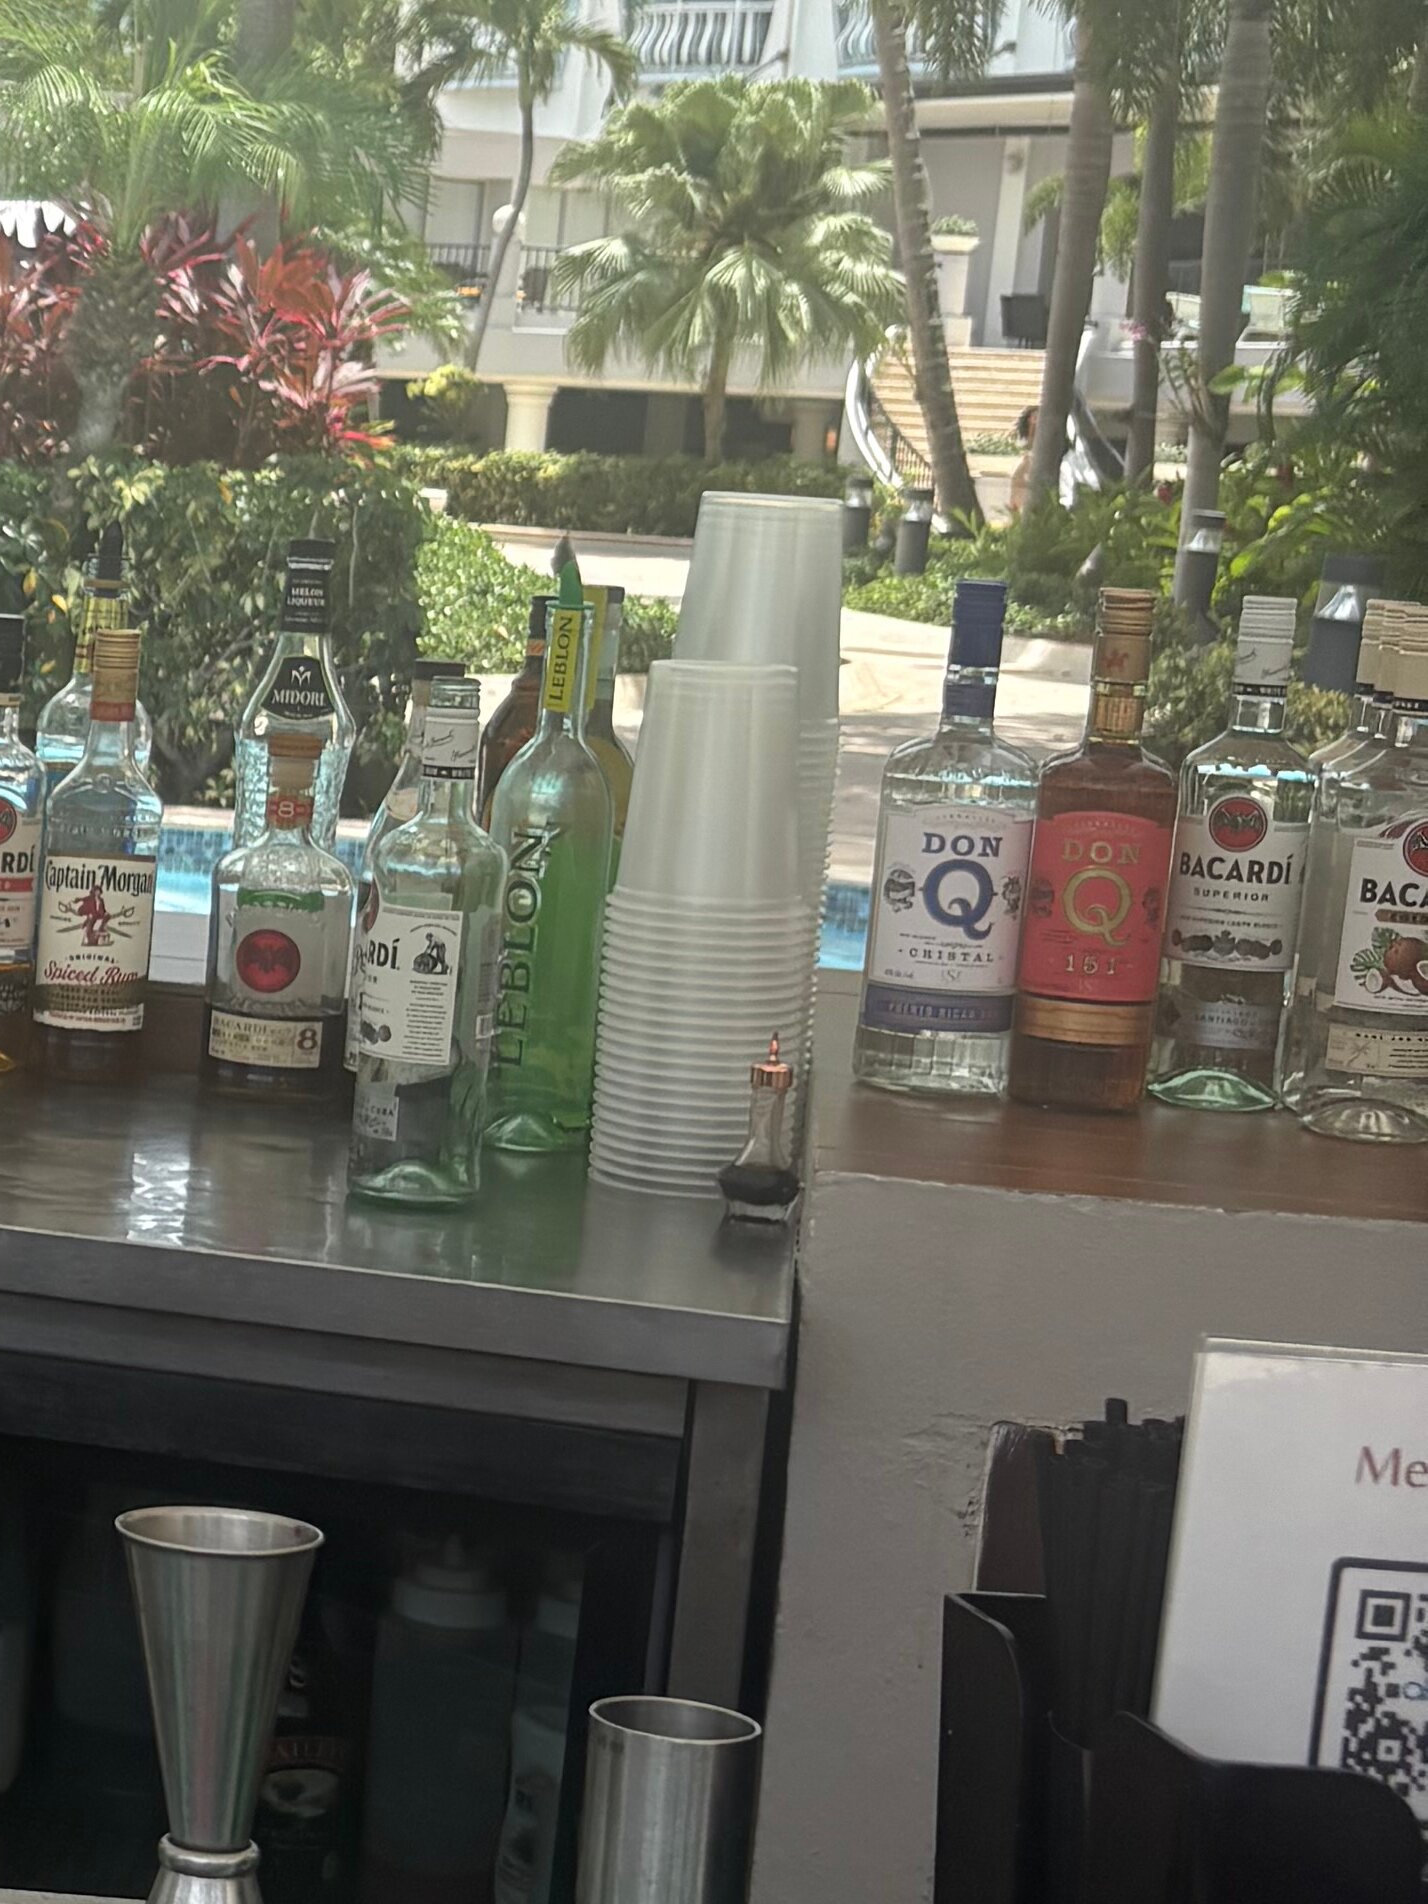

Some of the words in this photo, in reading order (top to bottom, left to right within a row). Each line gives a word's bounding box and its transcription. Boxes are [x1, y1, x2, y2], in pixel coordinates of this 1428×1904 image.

[551, 614, 576, 702] LEBLON
[271, 689, 326, 708] MIDORI
[277, 799, 295, 819] 8
[921, 832, 1004, 858] DON
[1062, 840, 1141, 865] DON
[45, 859, 97, 893] Captain
[97, 863, 153, 897] Morgan
[1179, 852, 1293, 886] BACARDÍ
[921, 858, 996, 942] Q
[1194, 886, 1270, 902] SUPERIOR
[1359, 876, 1428, 908] BACA
[1061, 865, 1134, 948] Q
[909, 947, 995, 963] CRISTAL
[1064, 953, 1118, 976] 151
[43, 959, 97, 984] Spiced
[99, 966, 139, 986] Rum
[296, 1027, 319, 1052] 8
[1355, 1443, 1428, 1489] Me
